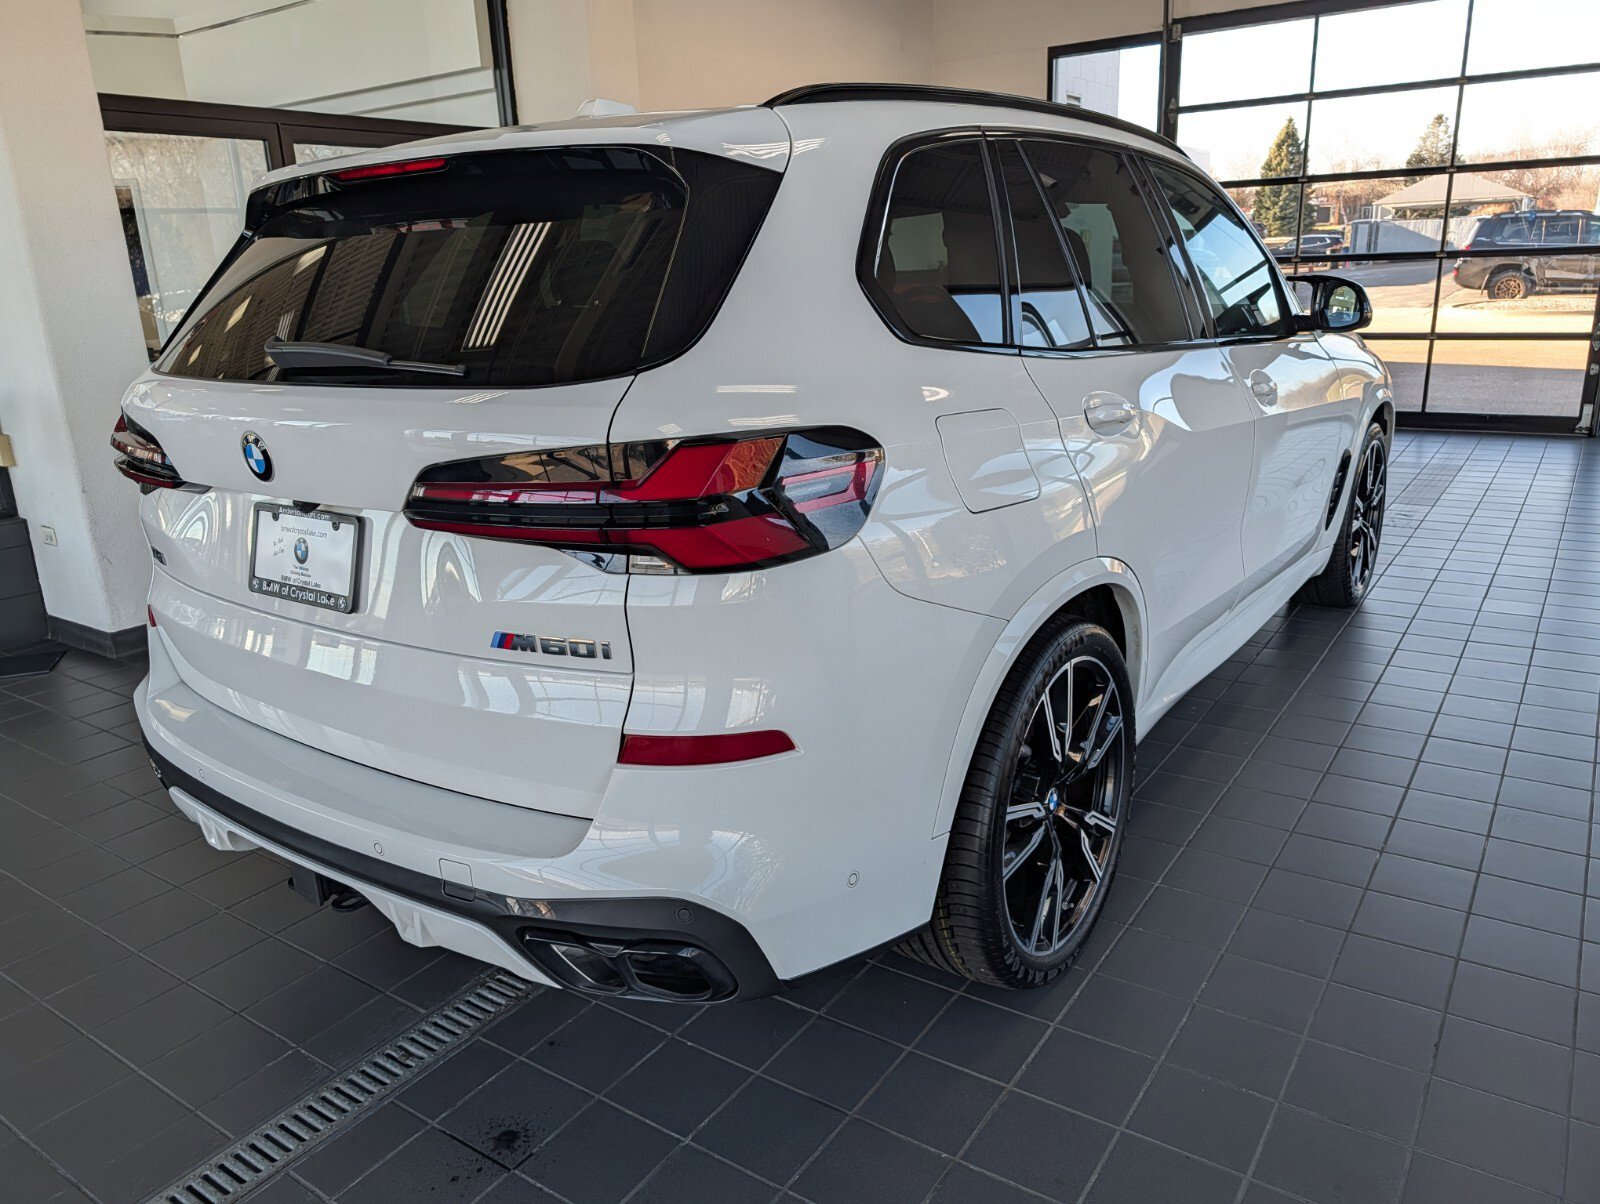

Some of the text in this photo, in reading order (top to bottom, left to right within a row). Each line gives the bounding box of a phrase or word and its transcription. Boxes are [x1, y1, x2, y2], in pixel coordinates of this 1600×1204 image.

[262, 581, 335, 606] BMW of Crystal Lake
[508, 632, 612, 660] M60i
